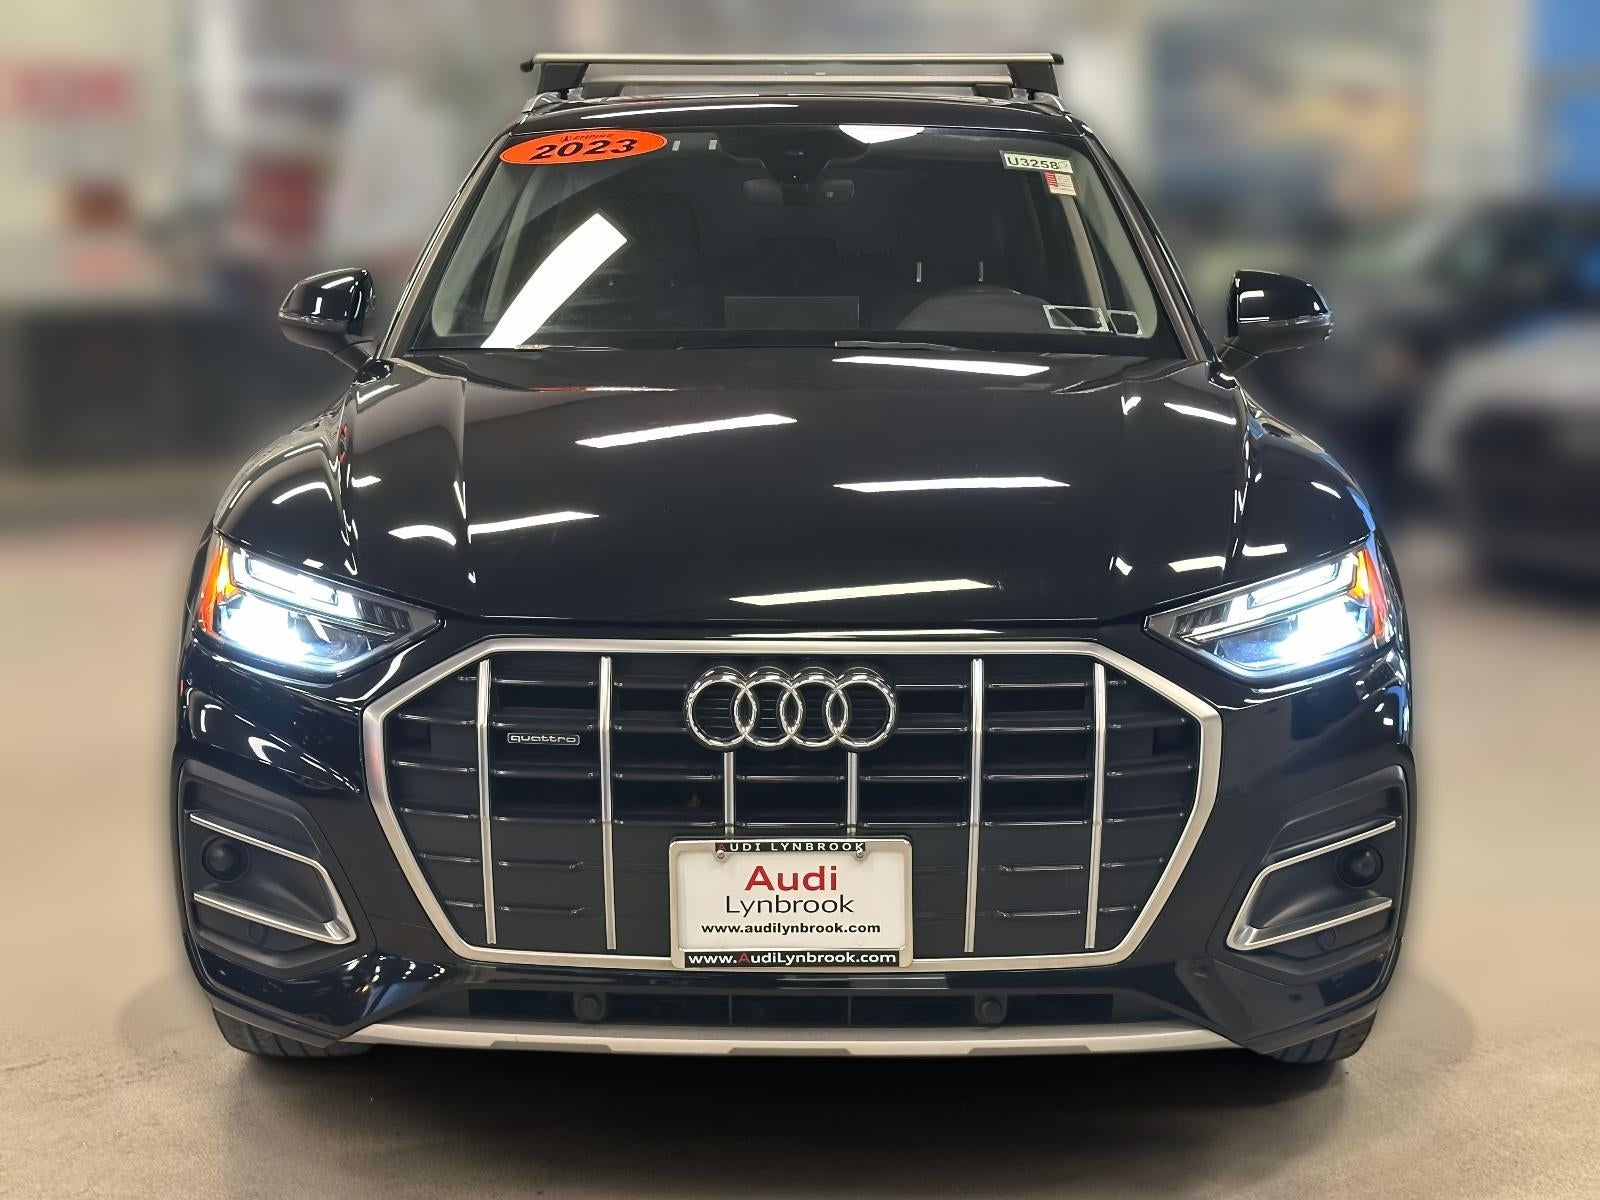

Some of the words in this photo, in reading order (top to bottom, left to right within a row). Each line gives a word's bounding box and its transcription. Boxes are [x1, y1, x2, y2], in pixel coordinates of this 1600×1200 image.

[528, 138, 638, 161] 2023
[510, 735, 576, 743] quattro
[718, 842, 761, 852] AUDI
[770, 842, 866, 852] LYNBROOK
[744, 865, 837, 891] Audi
[725, 894, 855, 918] Lynbrook
[701, 922, 881, 935] www.audilynbrook.com
[688, 951, 897, 966] www.AudiLynbrook.com
